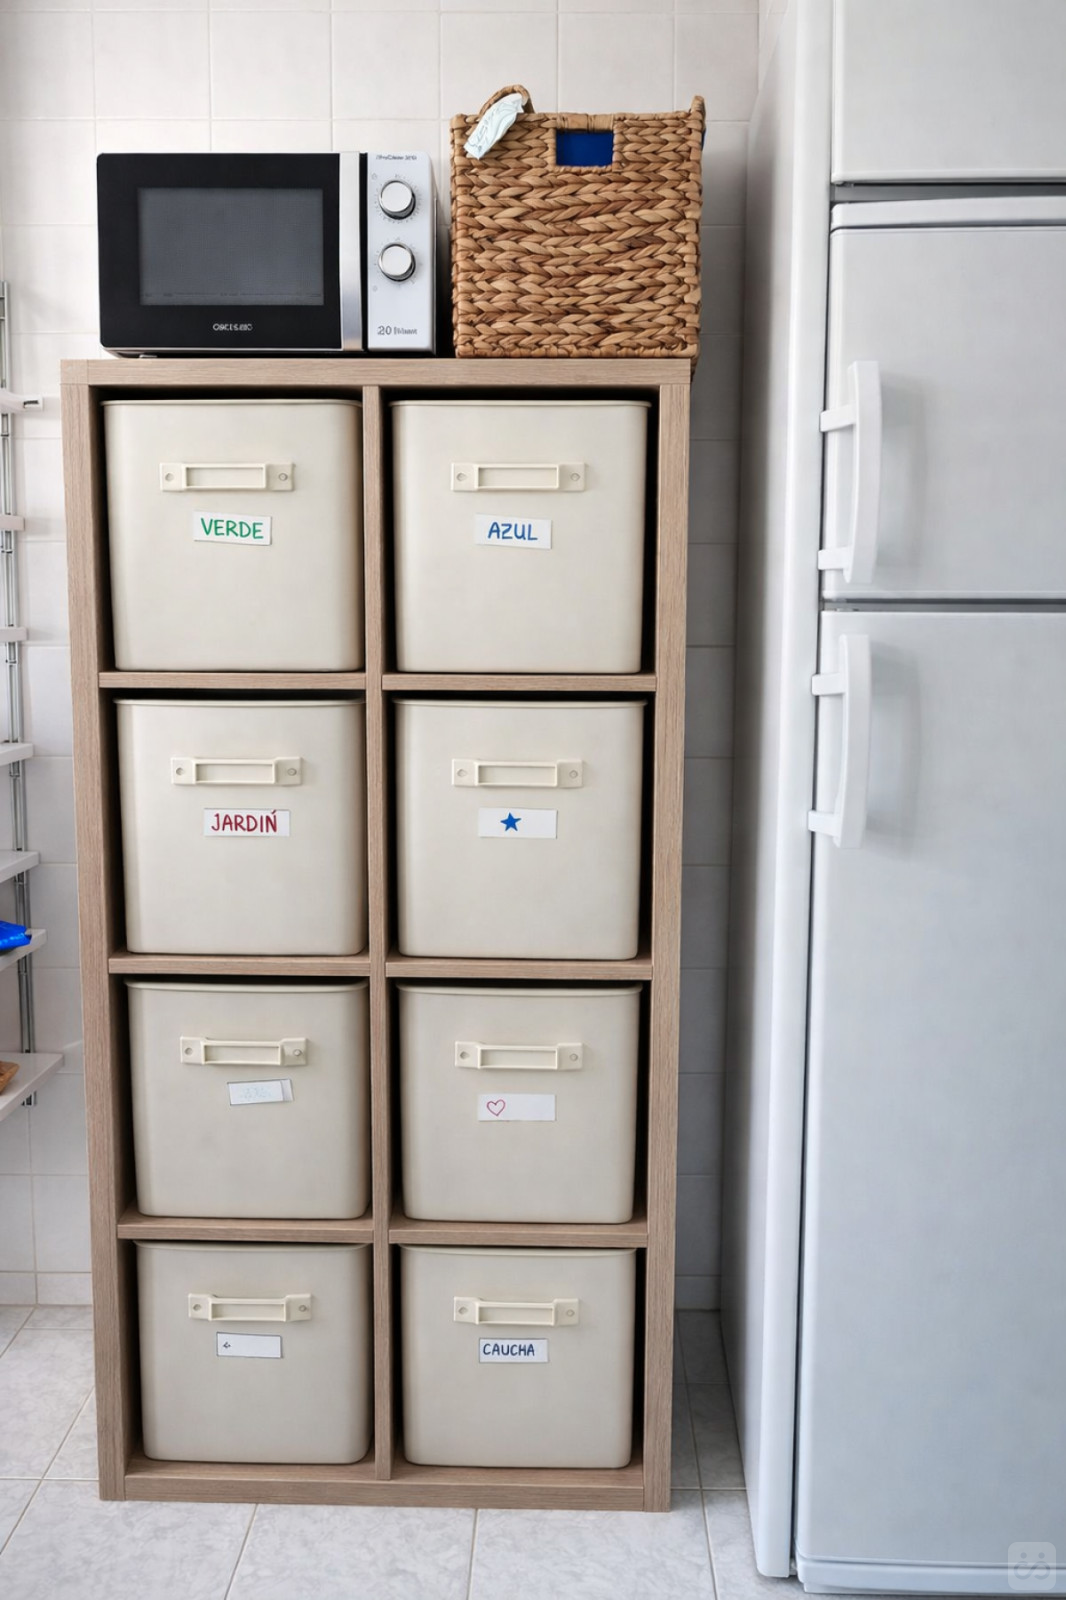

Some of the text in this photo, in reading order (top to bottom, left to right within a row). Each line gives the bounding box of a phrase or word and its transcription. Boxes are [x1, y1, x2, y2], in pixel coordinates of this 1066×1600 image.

[377, 325, 392, 336] 20
[200, 517, 264, 539] VERDE
[487, 521, 538, 541] AZUL
[483, 1343, 535, 1356] CAUCHA
